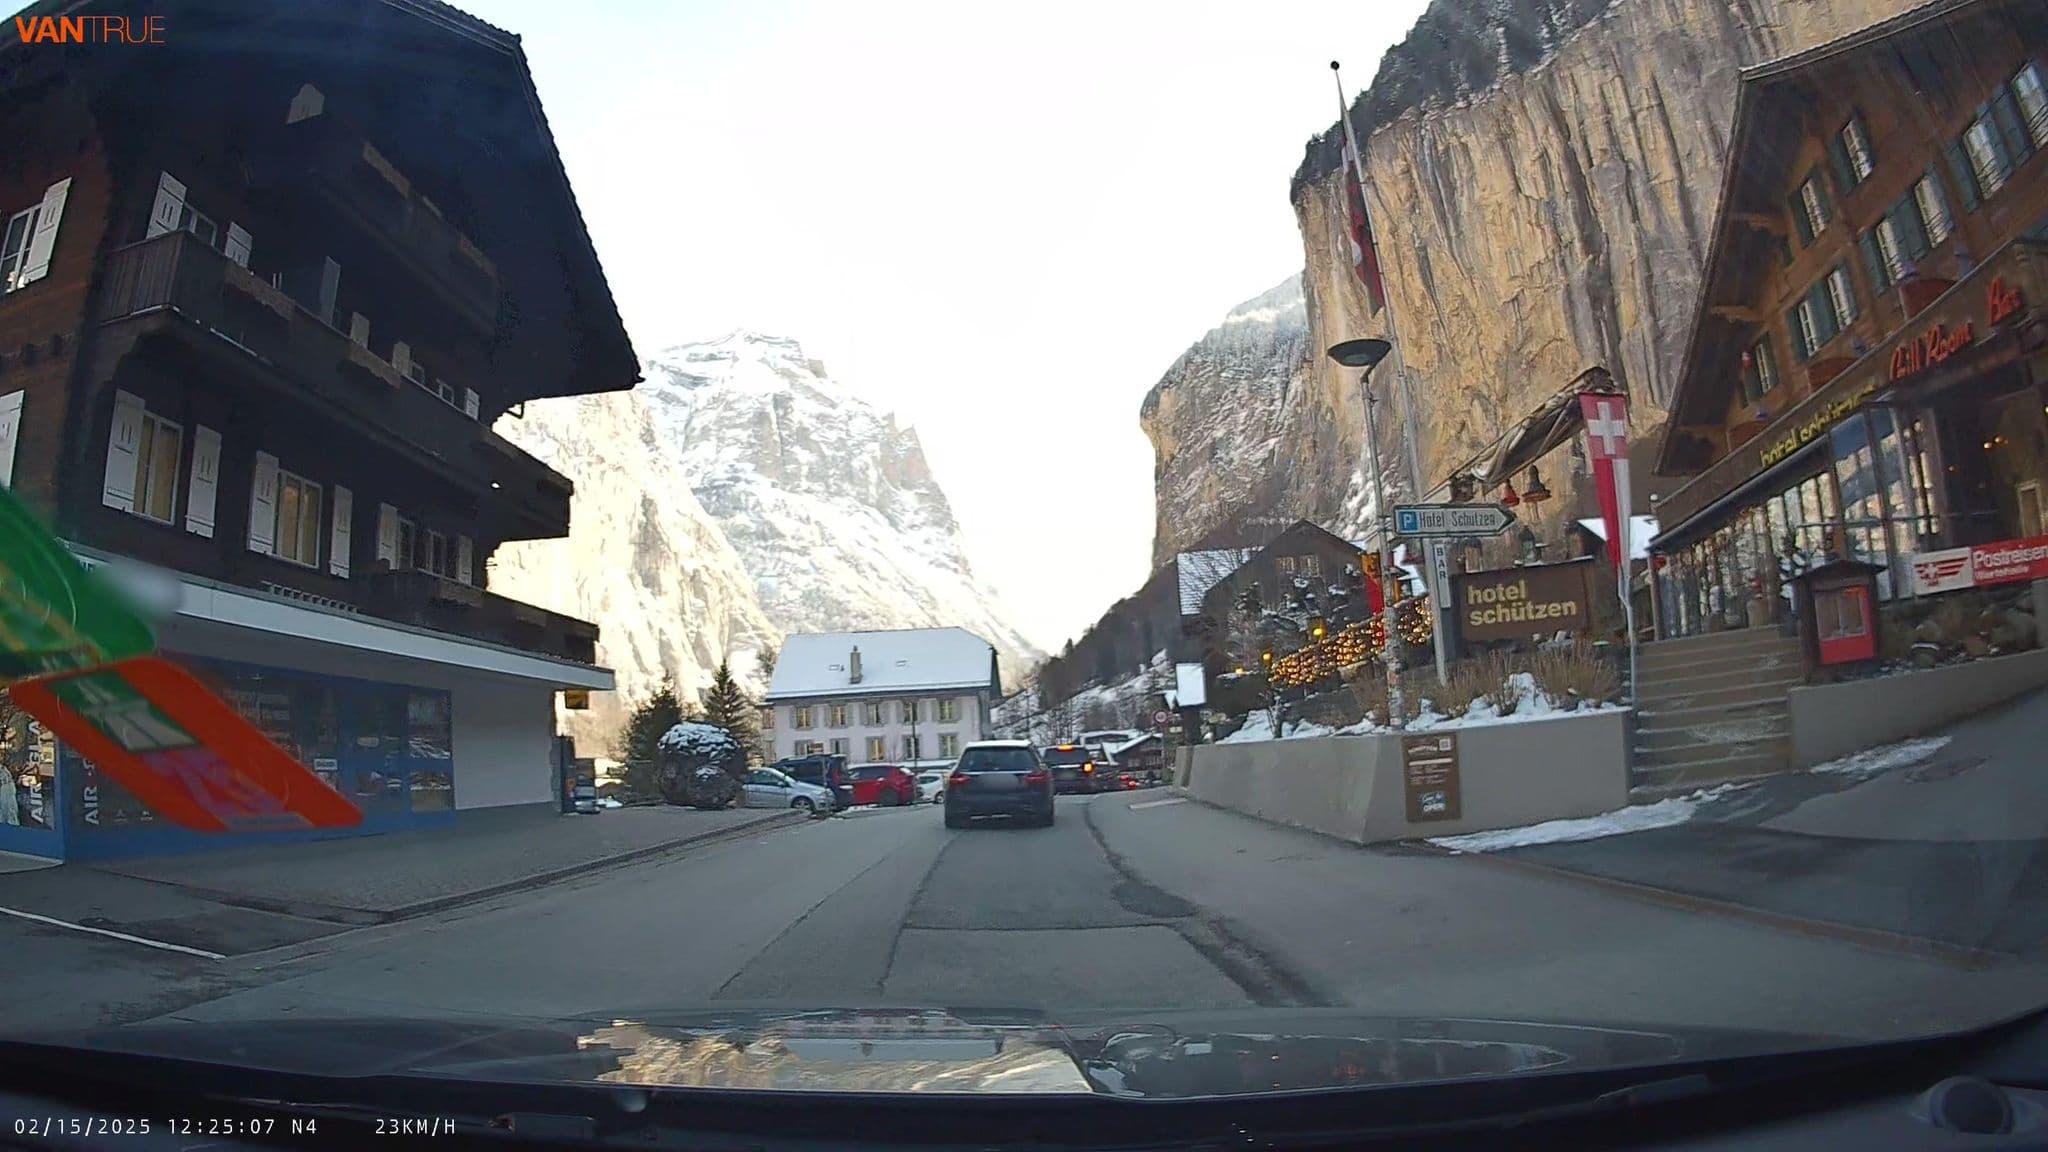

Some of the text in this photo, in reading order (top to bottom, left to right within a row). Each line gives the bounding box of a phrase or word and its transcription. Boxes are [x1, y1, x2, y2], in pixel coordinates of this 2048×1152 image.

[1924, 322, 1973, 366] Room
[1403, 514, 1413, 527] P
[1419, 511, 1445, 528] Hotel
[1436, 546, 1447, 580] BAR
[1467, 580, 1527, 605] hotel
[1469, 600, 1577, 626] schützen
[84, 785, 99, 825] AIR
